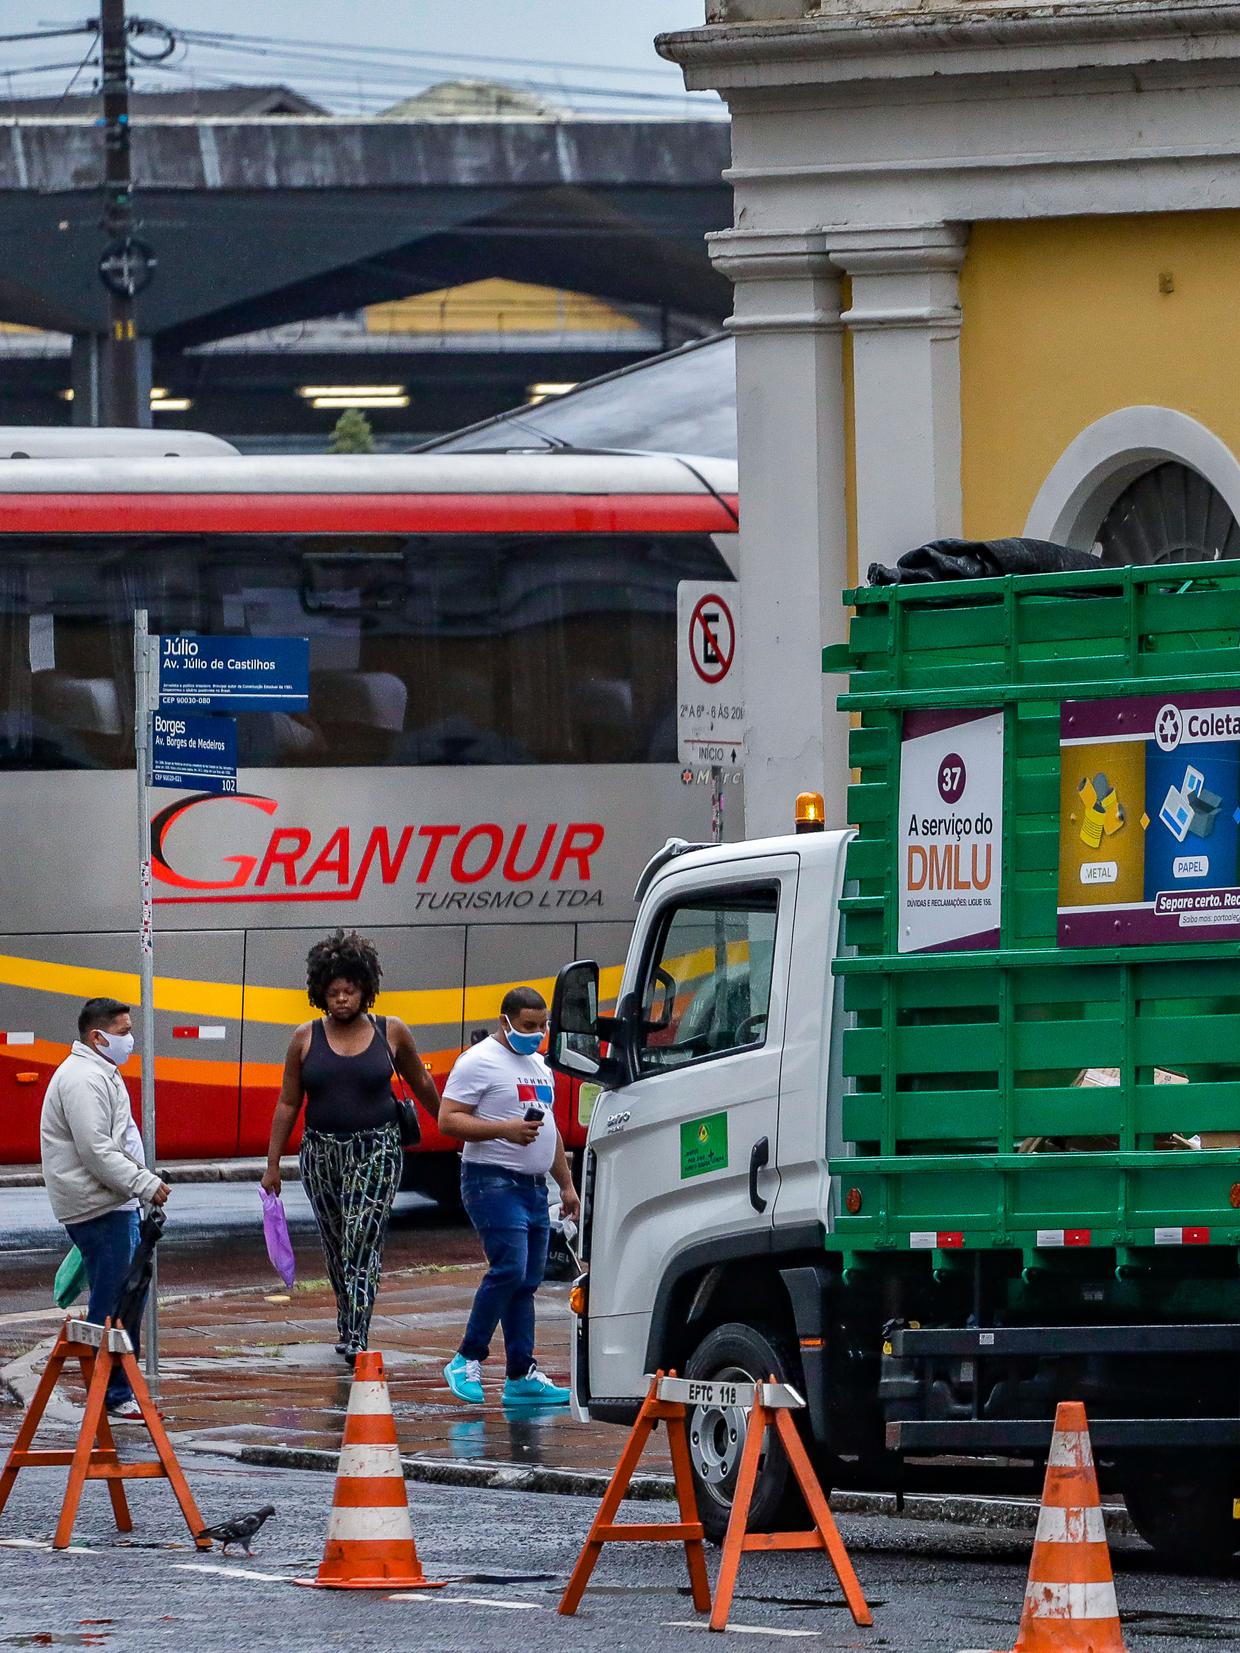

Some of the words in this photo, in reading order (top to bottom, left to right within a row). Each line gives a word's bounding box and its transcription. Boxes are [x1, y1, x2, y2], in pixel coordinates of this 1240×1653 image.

[163, 637, 199, 656] Júlio
[163, 658, 180, 669] Av.
[183, 657, 208, 669] Júlio
[210, 658, 224, 670] de
[227, 659, 276, 670] Castilhos
[688, 705, 696, 717] A
[710, 705, 716, 718] 6
[717, 703, 729, 719] ÀS
[155, 715, 186, 737] Borges
[155, 735, 165, 746] Av.
[166, 736, 187, 749] Borges
[188, 738, 197, 749] de
[197, 739, 225, 751] Medeiros
[698, 744, 724, 761] INÍCIO
[222, 779, 236, 792] 102
[942, 767, 962, 792] 37
[908, 814, 919, 836] A
[921, 812, 972, 842] serviço
[974, 812, 993, 835] do
[151, 792, 606, 897] GRANTOUR
[907, 843, 992, 891] DMLU
[1085, 866, 1112, 880] METAL
[1177, 861, 1204, 873] PAPEL
[415, 890, 534, 911] TURISMO
[967, 898, 982, 907] LIGUE
[1159, 896, 1193, 912] Separe
[1194, 893, 1223, 909] certo.
[1182, 914, 1198, 924] Saiba
[689, 1384, 713, 1401] EPTC
[720, 1386, 737, 1404] 118
